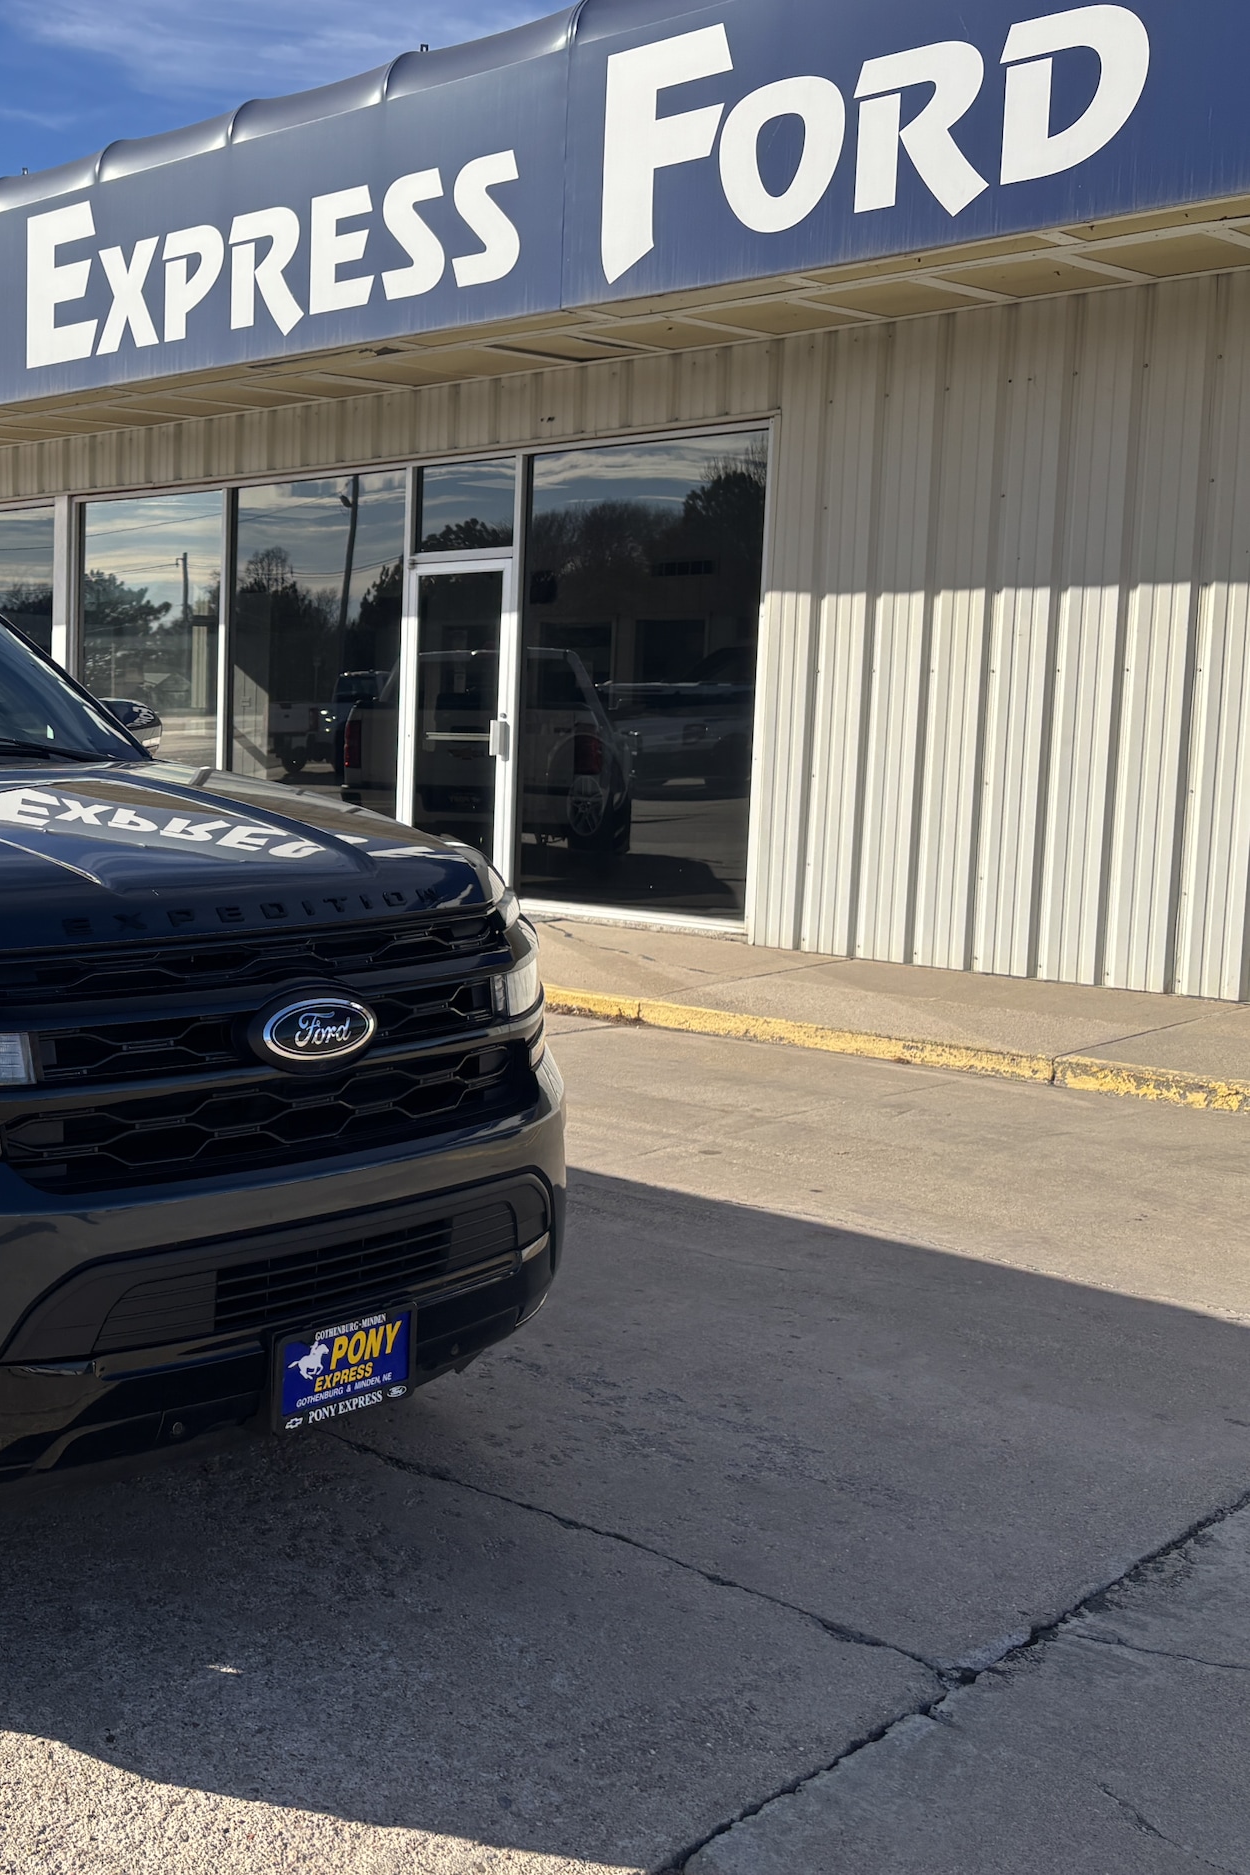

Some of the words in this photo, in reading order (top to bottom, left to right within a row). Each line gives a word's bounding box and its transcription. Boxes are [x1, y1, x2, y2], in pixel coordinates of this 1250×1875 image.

[24, 149, 520, 370] EXPRESS
[600, 4, 1150, 285] FORD
[61, 886, 439, 938] EXPEDITION
[293, 1010, 352, 1050] Ford
[314, 1313, 387, 1341] GOTHENBURG-MINDEN
[329, 1320, 402, 1370] PONY
[296, 1387, 344, 1408] GOTHENBURG
[382, 1372, 393, 1382] NE
[314, 1361, 374, 1392] EXPRESS
[307, 1404, 338, 1424] PONY
[338, 1390, 384, 1414] EXPRESS
